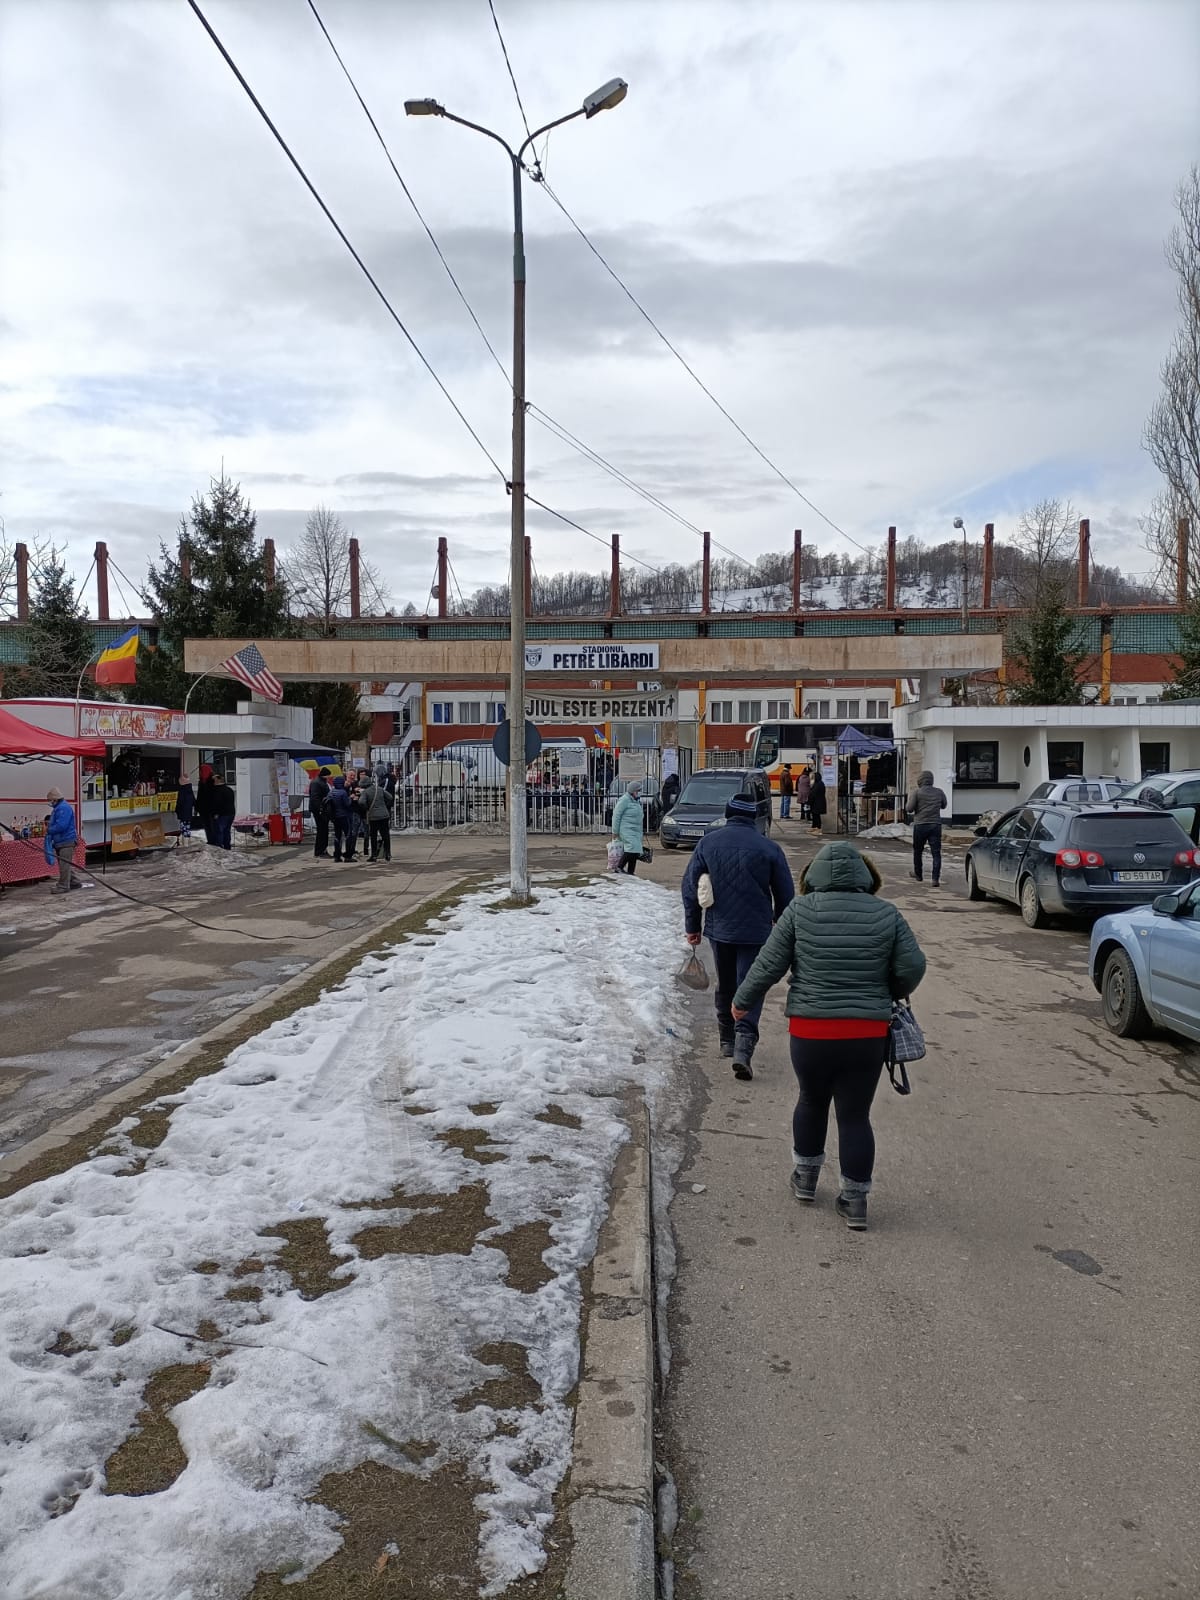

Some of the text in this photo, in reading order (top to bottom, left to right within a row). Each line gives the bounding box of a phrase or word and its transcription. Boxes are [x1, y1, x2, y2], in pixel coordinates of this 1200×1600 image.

[582, 645, 625, 654] STADIONUL
[553, 652, 653, 669] PETRE LIBARDI
[525, 699, 666, 718] JIUL ESTE PREZENT
[1118, 872, 1132, 880] HD
